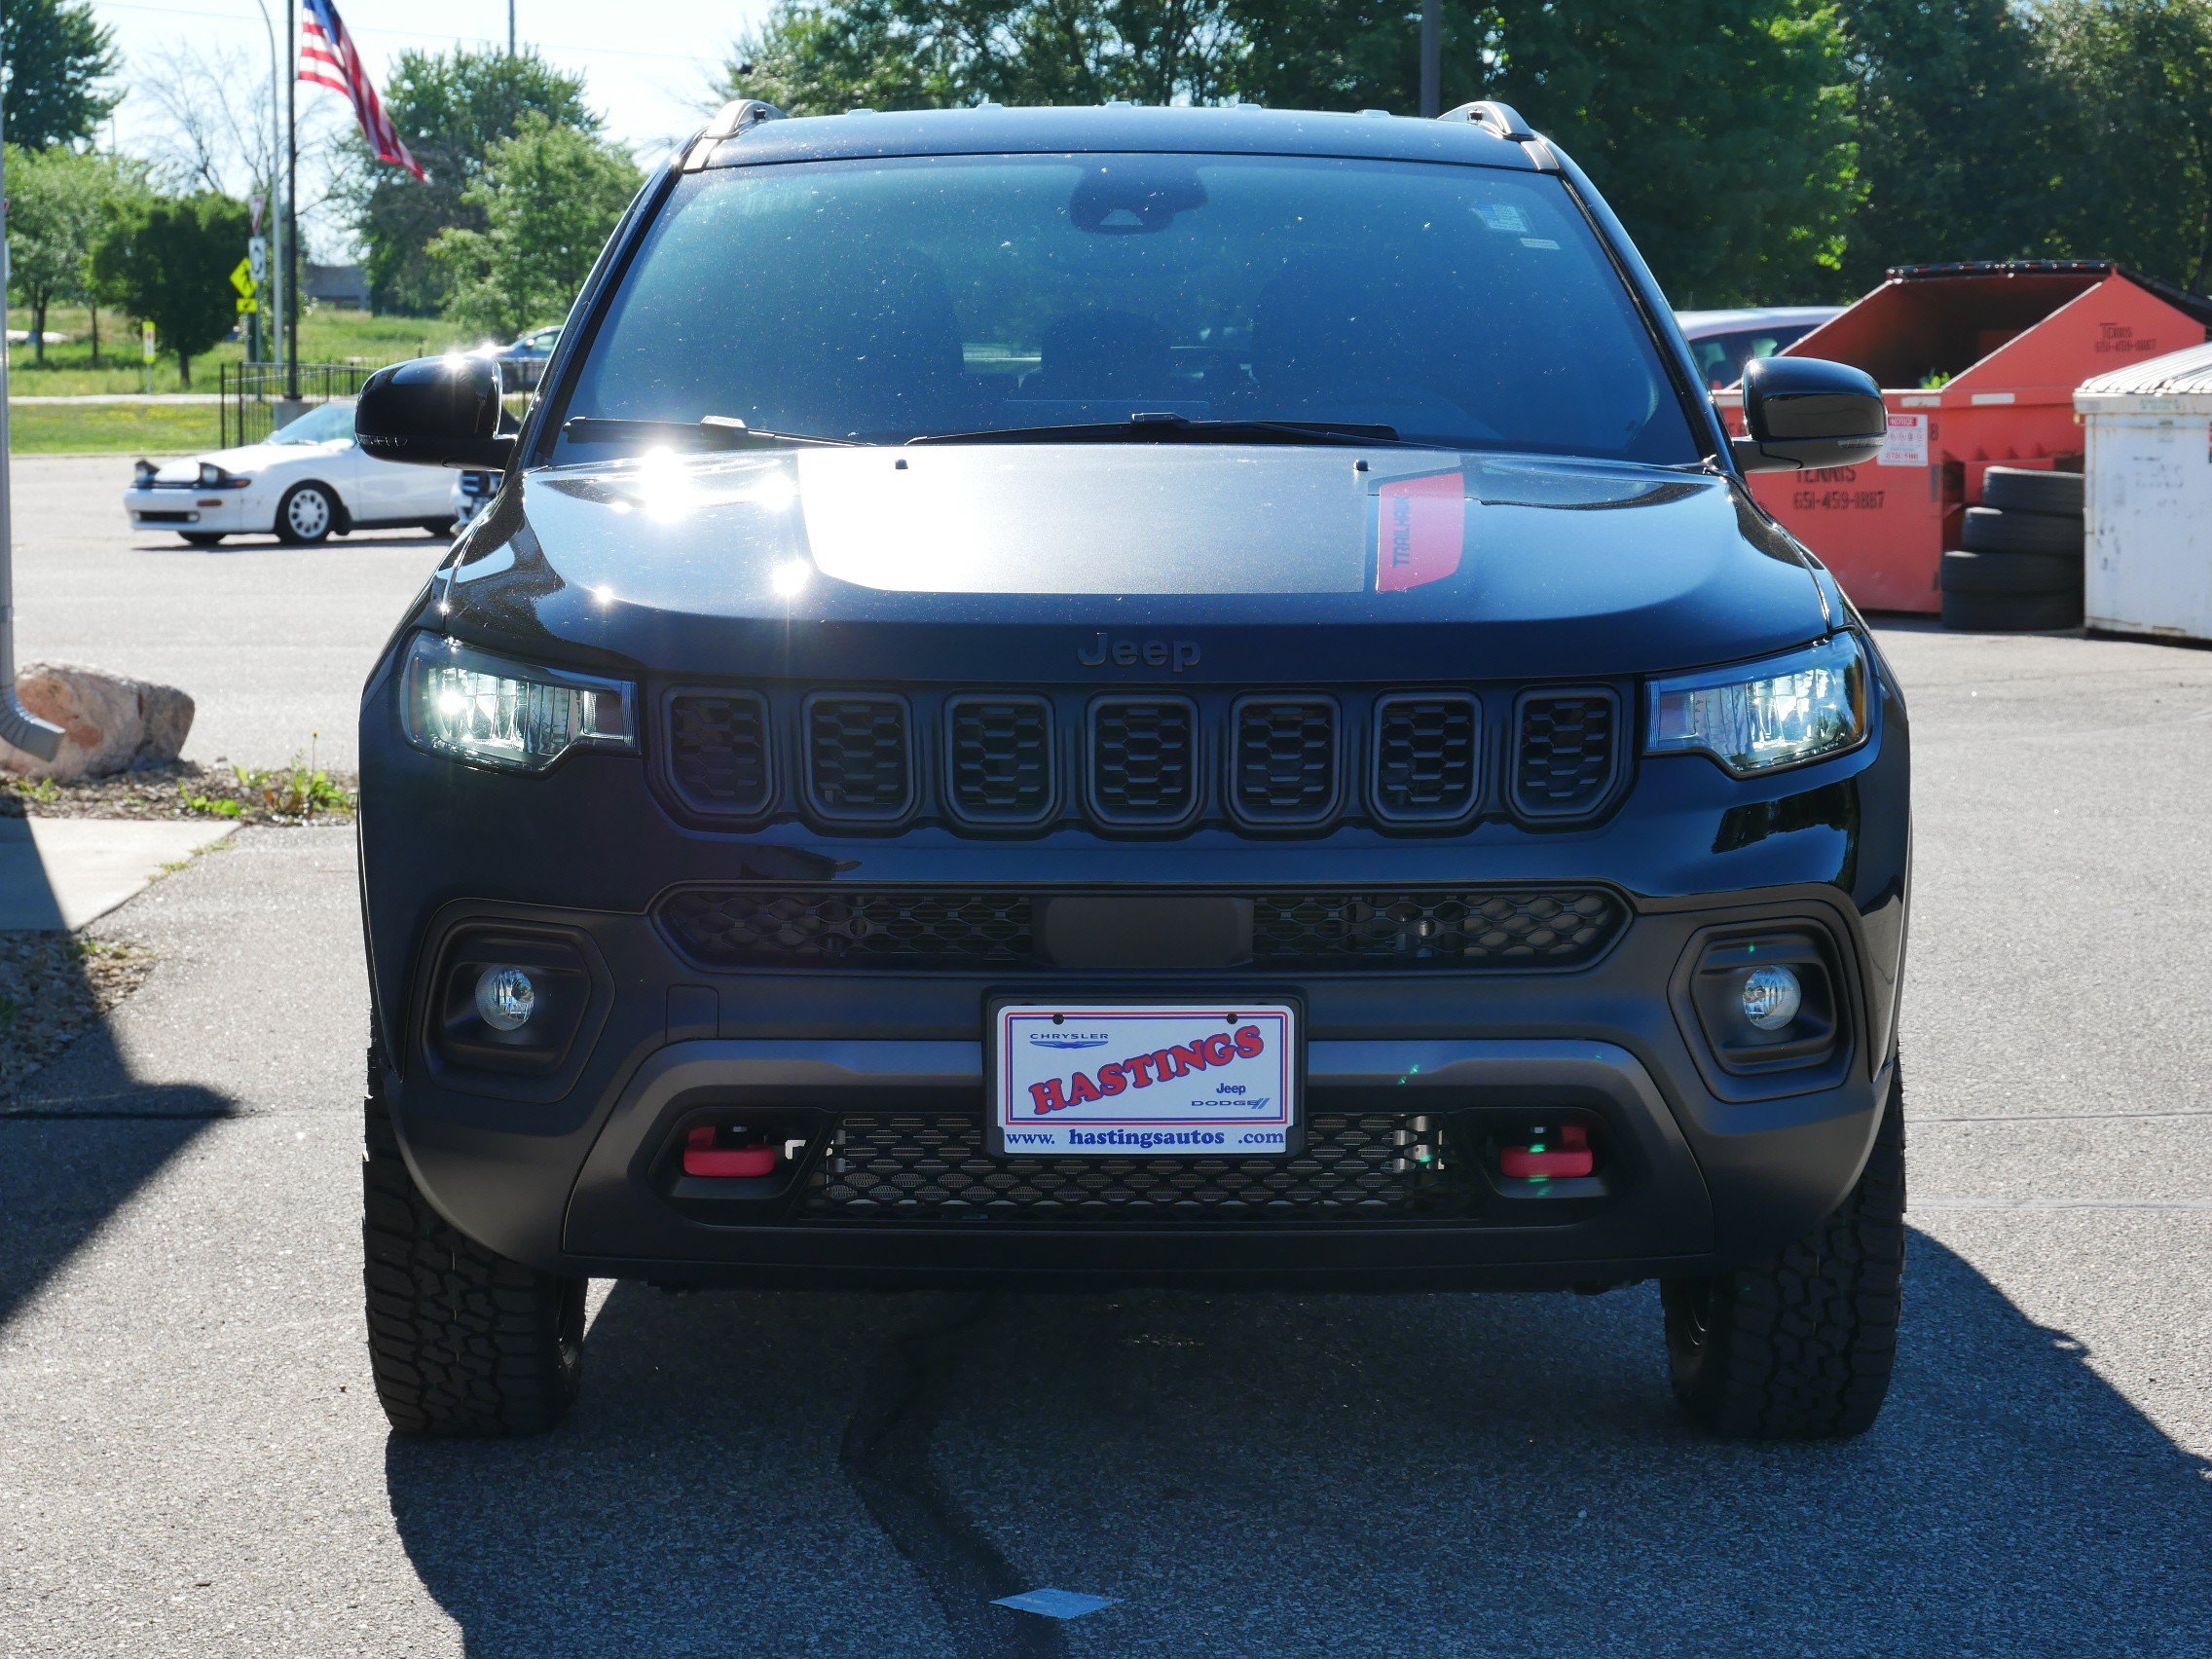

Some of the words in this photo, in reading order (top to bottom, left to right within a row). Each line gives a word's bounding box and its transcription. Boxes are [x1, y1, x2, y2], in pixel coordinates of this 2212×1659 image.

[1077, 632, 1201, 673] Jeep
[1028, 1025, 1264, 1115] HASTINGS
[1216, 1083, 1246, 1095] Jeep
[1007, 1133, 1055, 1145] www.
[1069, 1129, 1225, 1149] hastingsautos
[1237, 1132, 1285, 1144] .com
